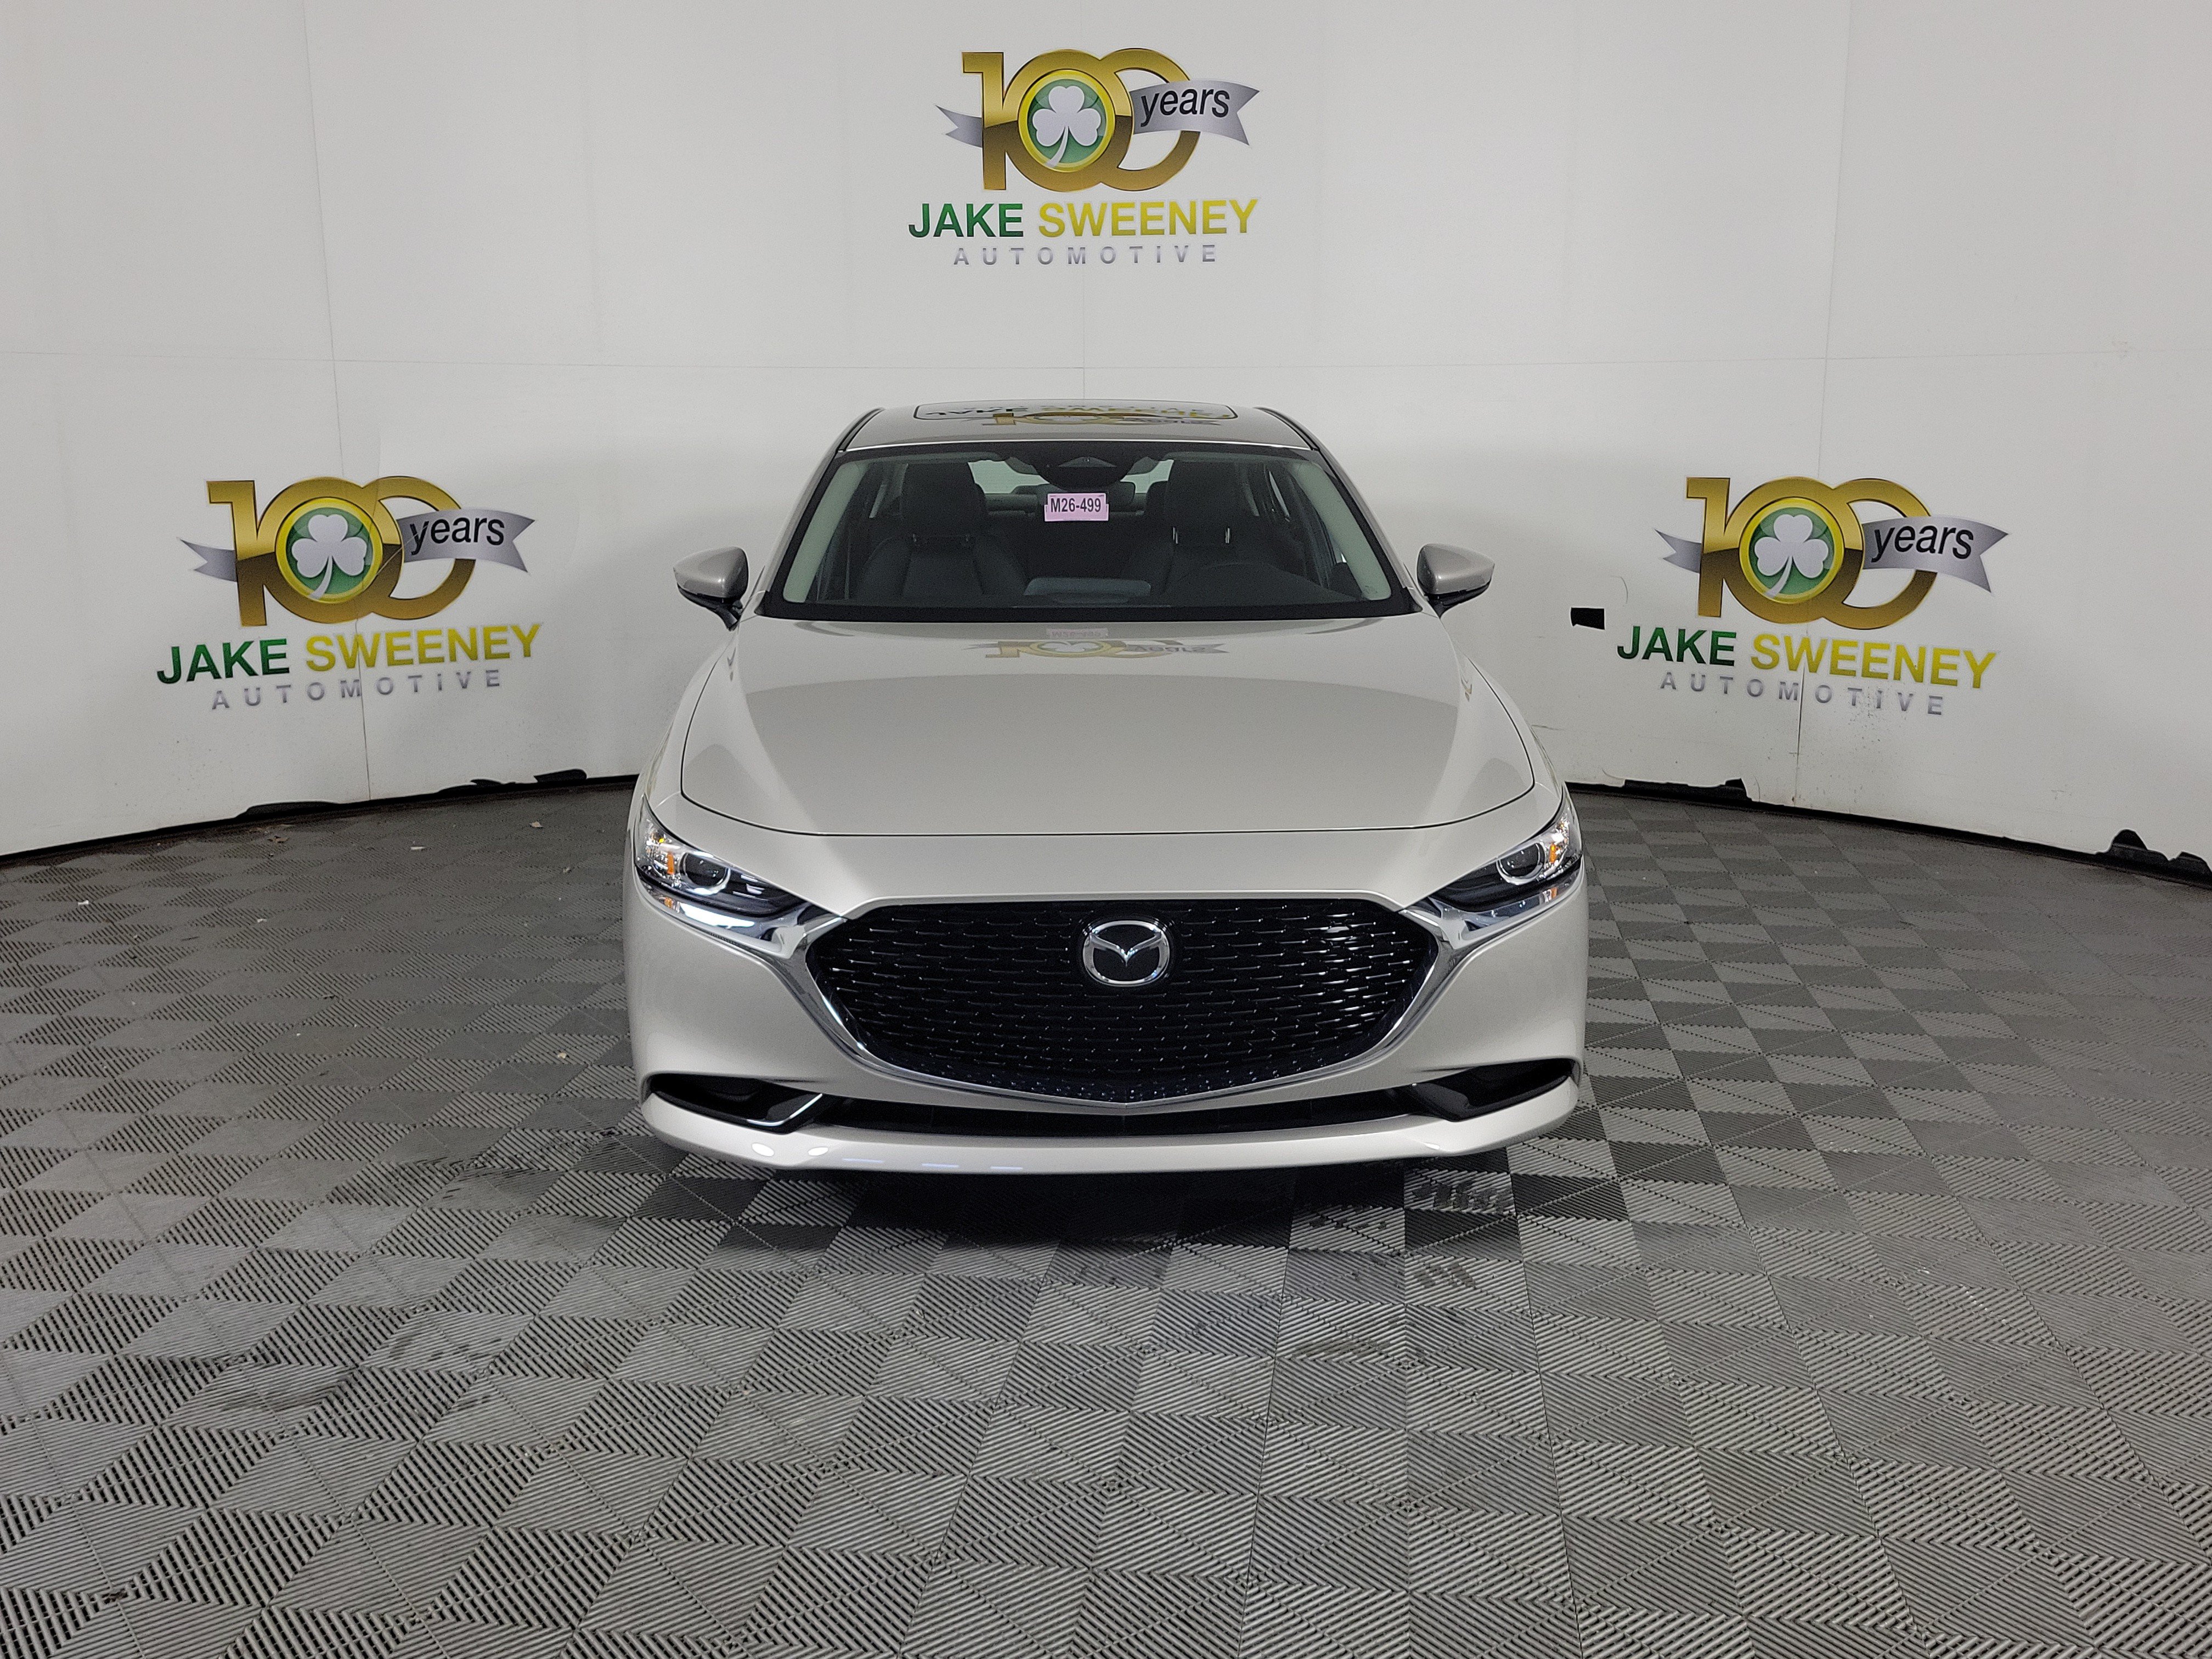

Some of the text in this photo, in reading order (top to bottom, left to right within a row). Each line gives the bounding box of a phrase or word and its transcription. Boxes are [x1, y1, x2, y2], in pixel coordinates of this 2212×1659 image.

[962, 48, 1230, 193] 100 years
[909, 199, 1259, 238] JAKE SWEENEY
[953, 244, 1216, 265] AUTOMOTIVE
[1051, 498, 1101, 512] M26-499
[206, 476, 505, 627] 100 years
[1686, 476, 1974, 630] 100 years
[157, 623, 542, 684] JAKE SWEENEY
[1617, 625, 1997, 689] JAKE SWEENEY
[211, 670, 500, 710] AUTOMOTIVE
[1660, 672, 1944, 715] AUTOMOTIVE
